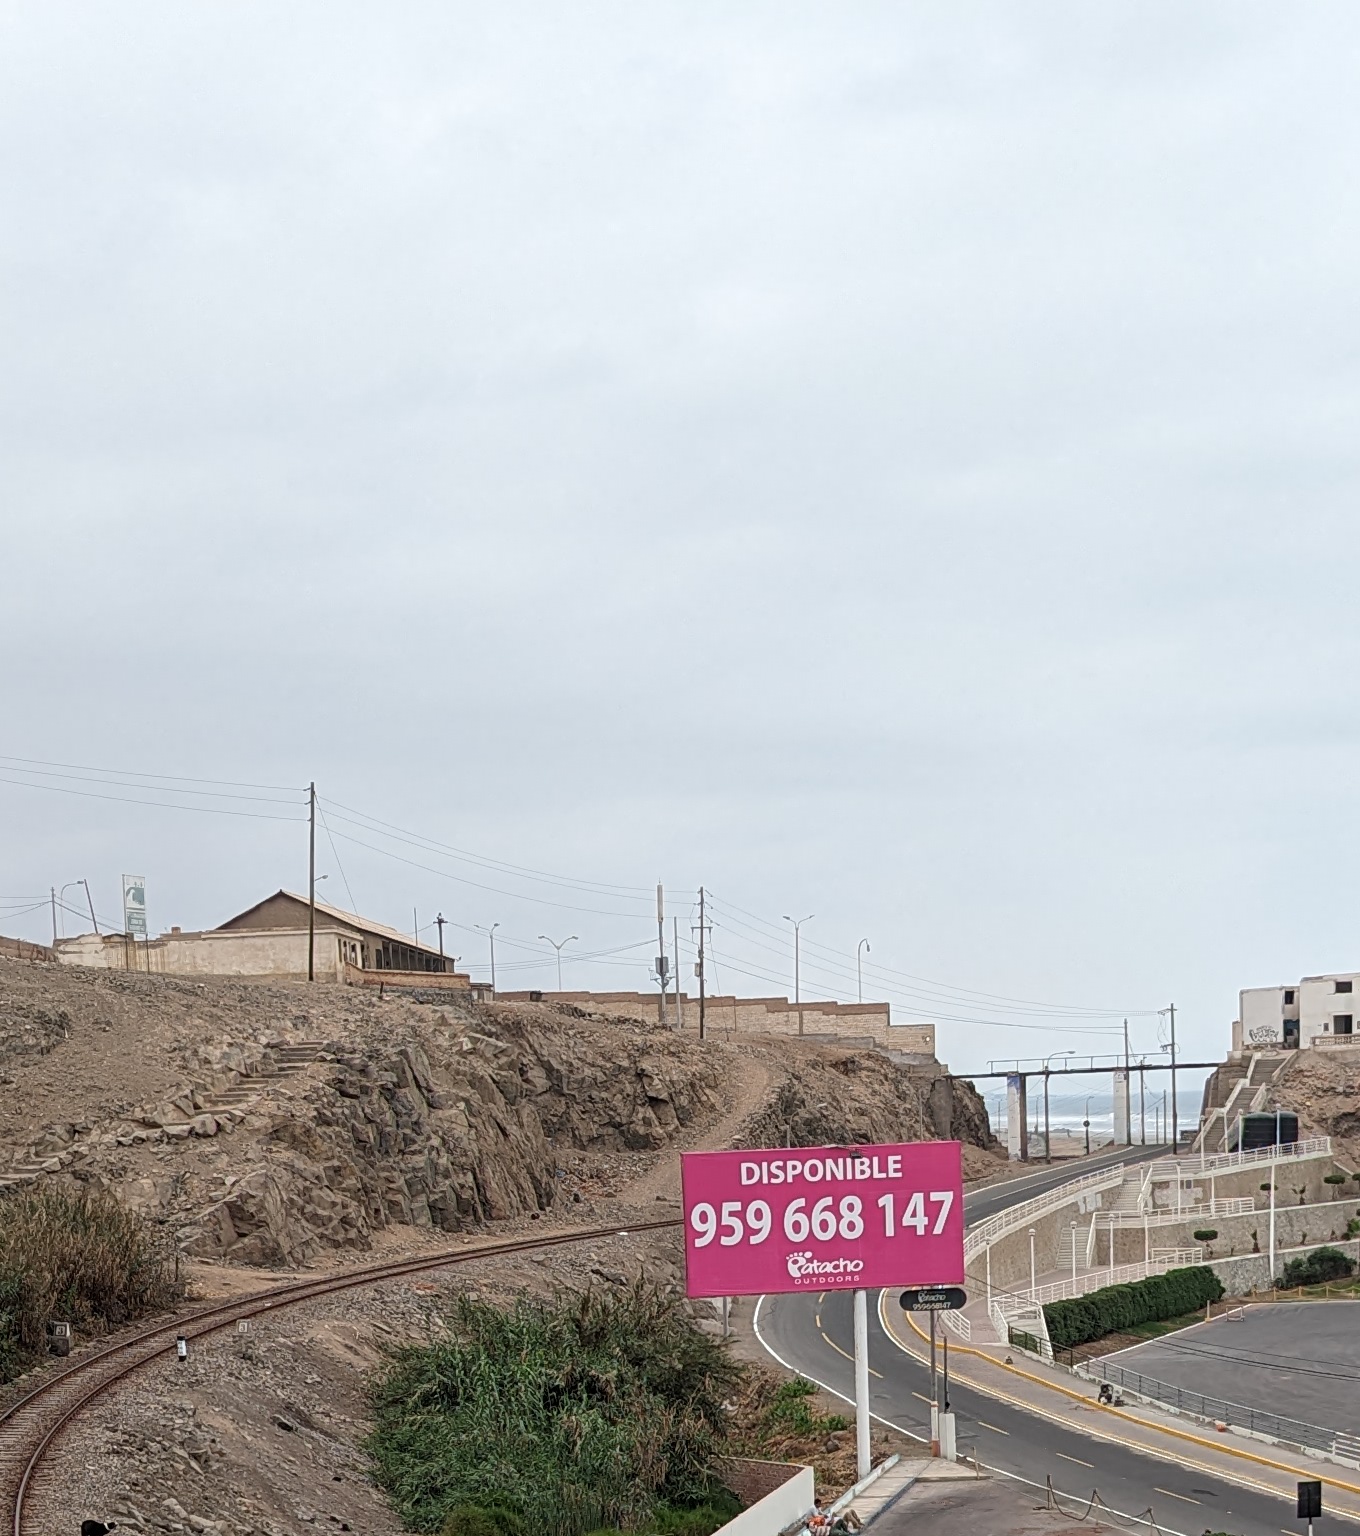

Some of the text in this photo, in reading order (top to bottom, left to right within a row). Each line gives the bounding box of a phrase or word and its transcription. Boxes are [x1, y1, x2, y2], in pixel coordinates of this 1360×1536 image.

[740, 1155, 903, 1185] DISPONIBLE
[690, 1191, 954, 1248] 959 668 147
[787, 1254, 864, 1277] Patacho
[794, 1275, 860, 1285] OUTDOORS
